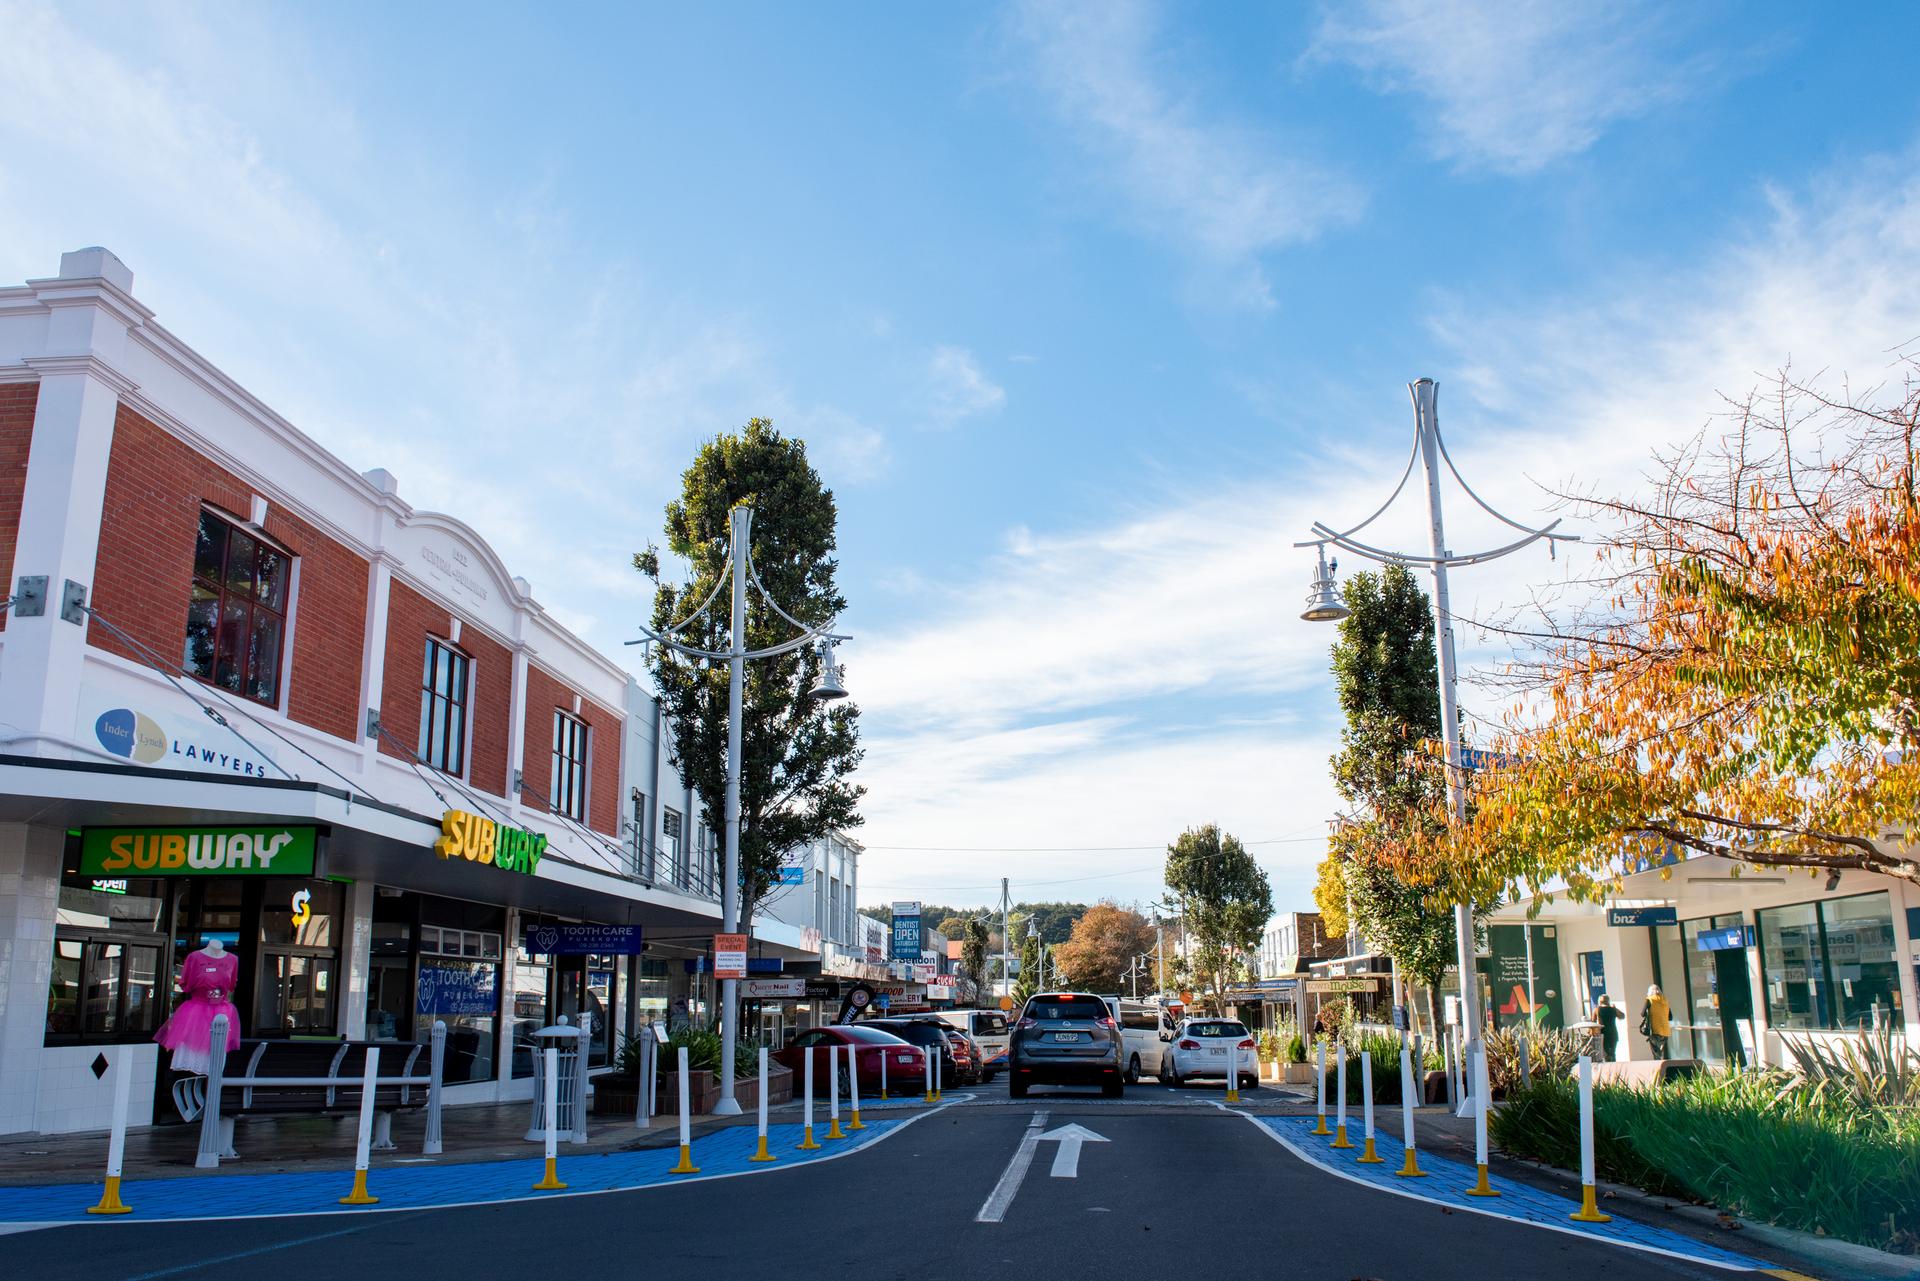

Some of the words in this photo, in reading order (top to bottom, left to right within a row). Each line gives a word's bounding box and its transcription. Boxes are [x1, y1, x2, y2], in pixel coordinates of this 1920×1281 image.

[104, 721, 130, 739] Inder
[139, 733, 164, 748] Lynch
[173, 741, 265, 777] LAWYERS
[434, 809, 549, 876] SUBWAY
[101, 831, 294, 872] SUBWAY
[1613, 913, 1636, 924] bnz
[562, 927, 600, 935] TOOTH
[602, 927, 633, 935] CARE
[895, 921, 919, 929] DENTIST
[895, 929, 919, 940] OPEN
[1727, 933, 1741, 946] bnz
[936, 975, 957, 986] SUSHI
[1591, 971, 1604, 987] bnz
[806, 986, 829, 996] Factory
[906, 994, 920, 1003] ERY
